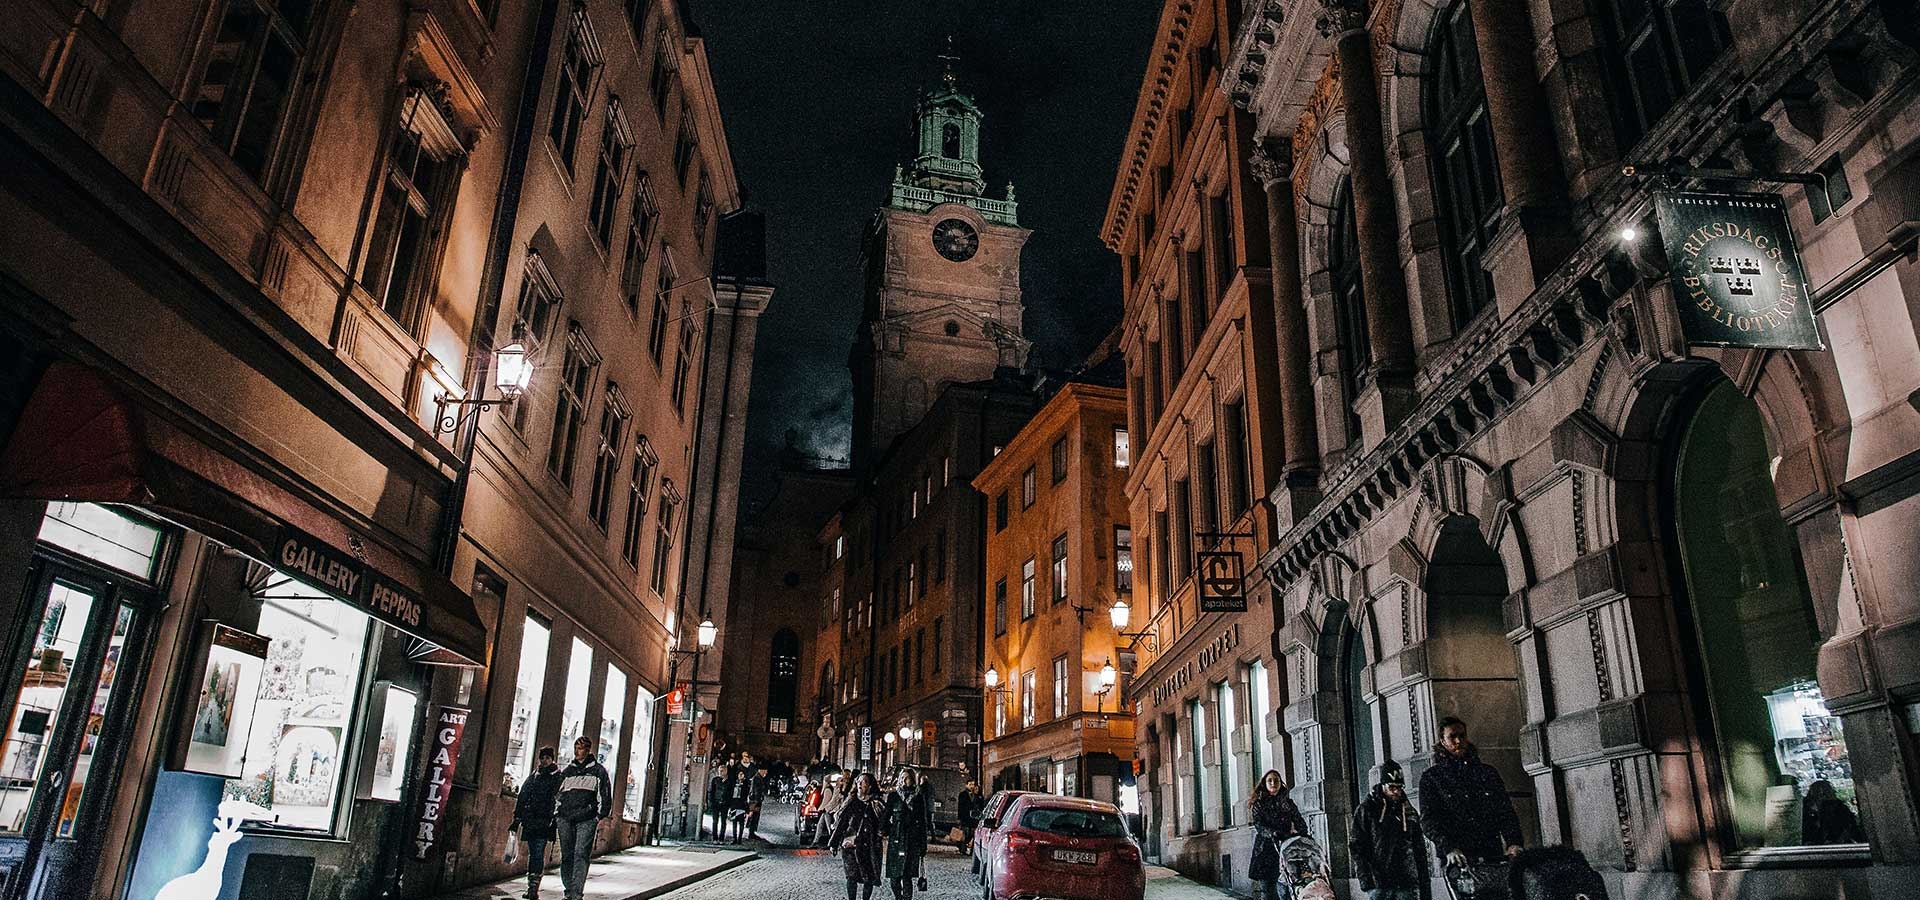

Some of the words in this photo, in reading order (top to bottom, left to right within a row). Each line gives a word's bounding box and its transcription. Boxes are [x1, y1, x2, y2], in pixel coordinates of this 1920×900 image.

[1727, 200, 1777, 209] RIKSDAG
[1682, 221, 1781, 260] RIKSDAGS
[1683, 274, 1797, 333] BIBLIOTEKET
[281, 538, 360, 596] GALLERY
[370, 583, 422, 627] PEPPAS
[1204, 599, 1244, 609] apoteket
[1196, 623, 1240, 674] KORPEN
[439, 712, 467, 726] ART
[415, 727, 457, 860] GALLERY
